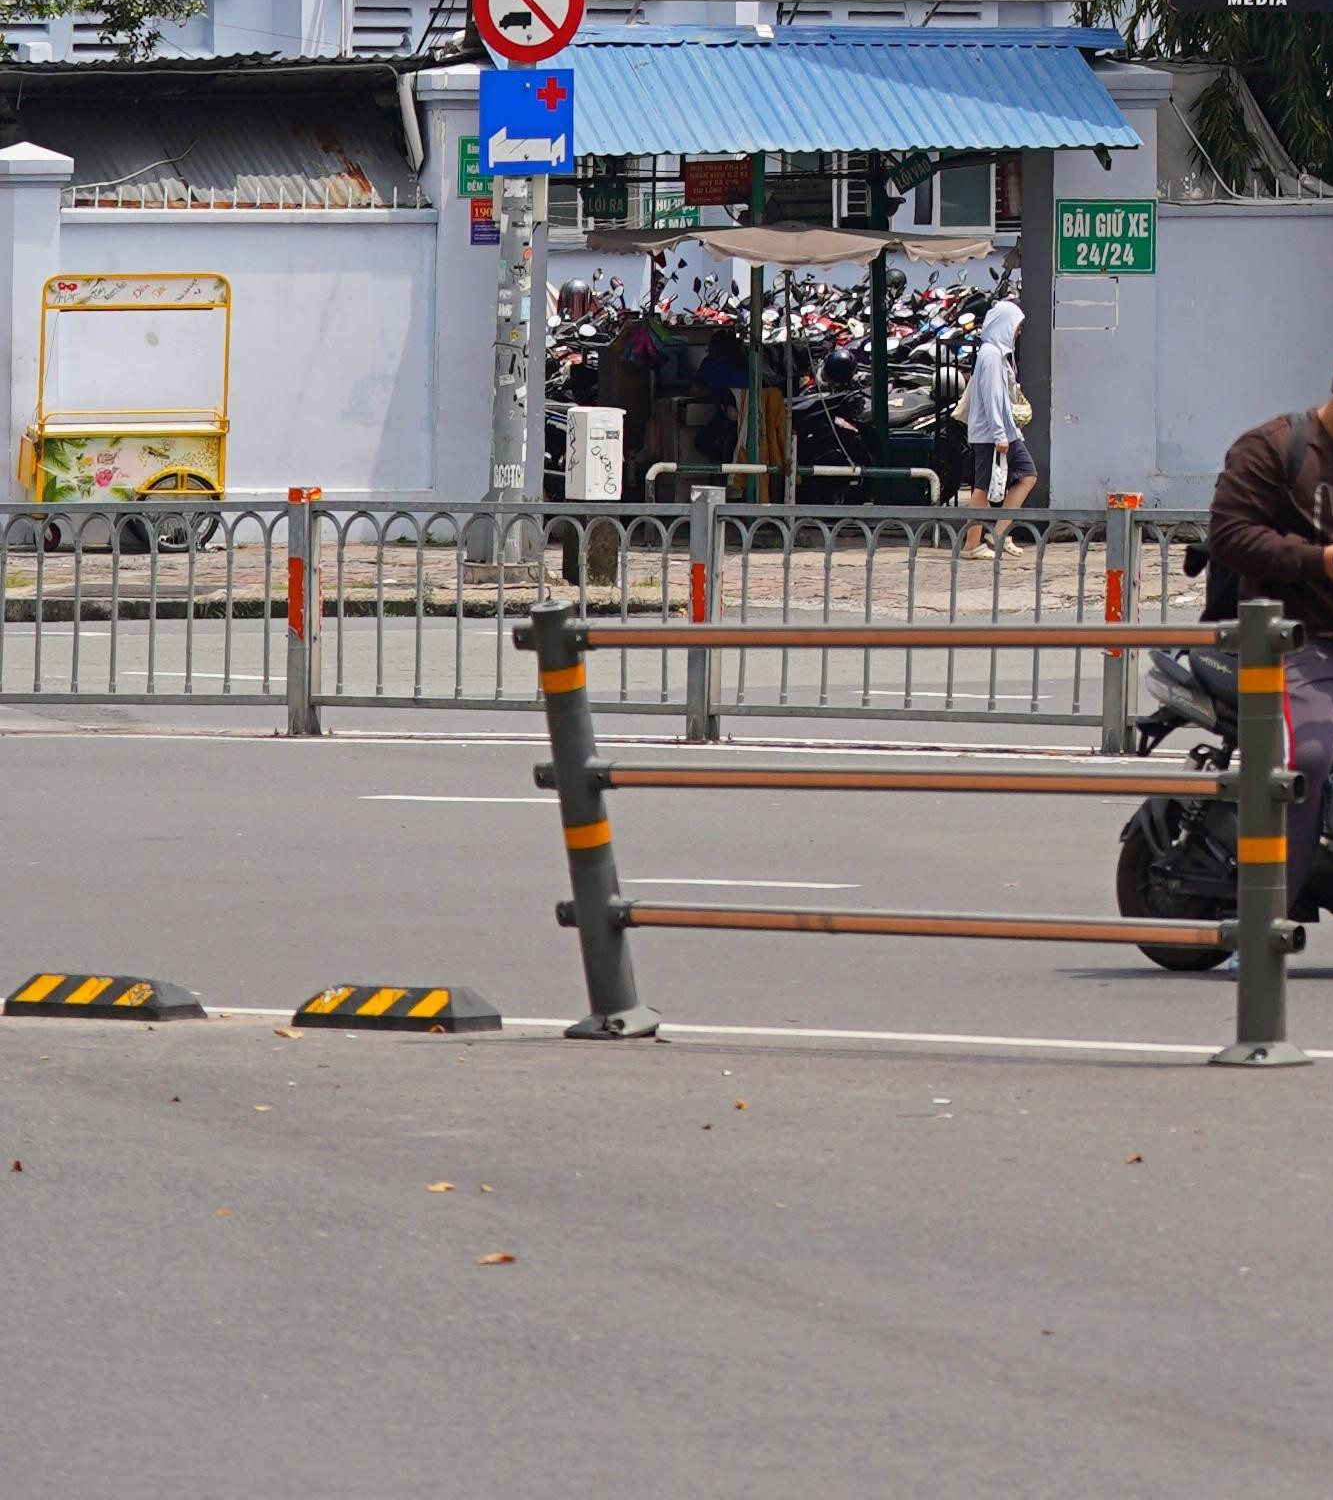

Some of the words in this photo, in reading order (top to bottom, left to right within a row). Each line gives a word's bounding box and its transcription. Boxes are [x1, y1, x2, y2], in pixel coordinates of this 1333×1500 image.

[588, 194, 606, 213] LỐI
[609, 199, 624, 213] RA
[1063, 208, 1090, 238] BÃI
[1095, 208, 1125, 238] GIỮ
[1128, 213, 1149, 238] XE
[1076, 242, 1135, 266] 24/24
